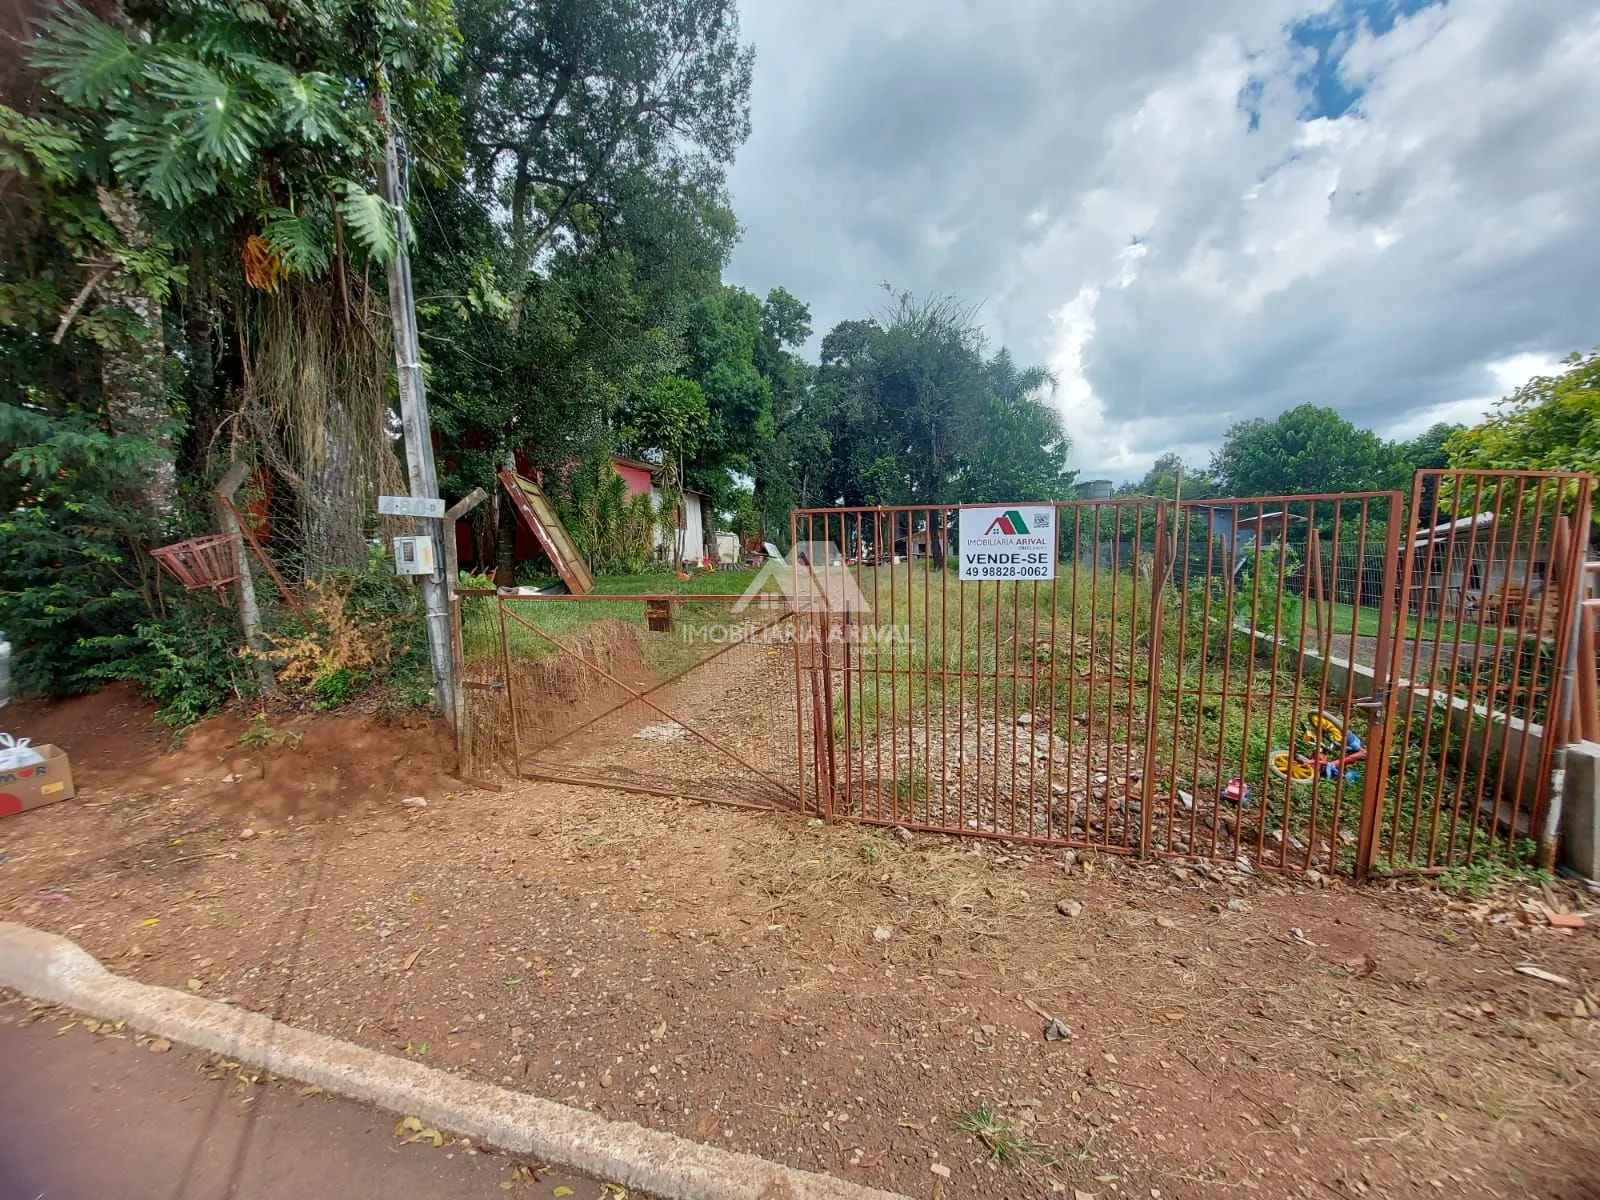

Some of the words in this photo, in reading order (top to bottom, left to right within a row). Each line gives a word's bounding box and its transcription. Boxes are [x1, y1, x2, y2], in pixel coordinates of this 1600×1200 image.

[966, 553, 1048, 564] VENDE-SE
[965, 567, 979, 577] 49
[982, 566, 1048, 577] 98828-0062
